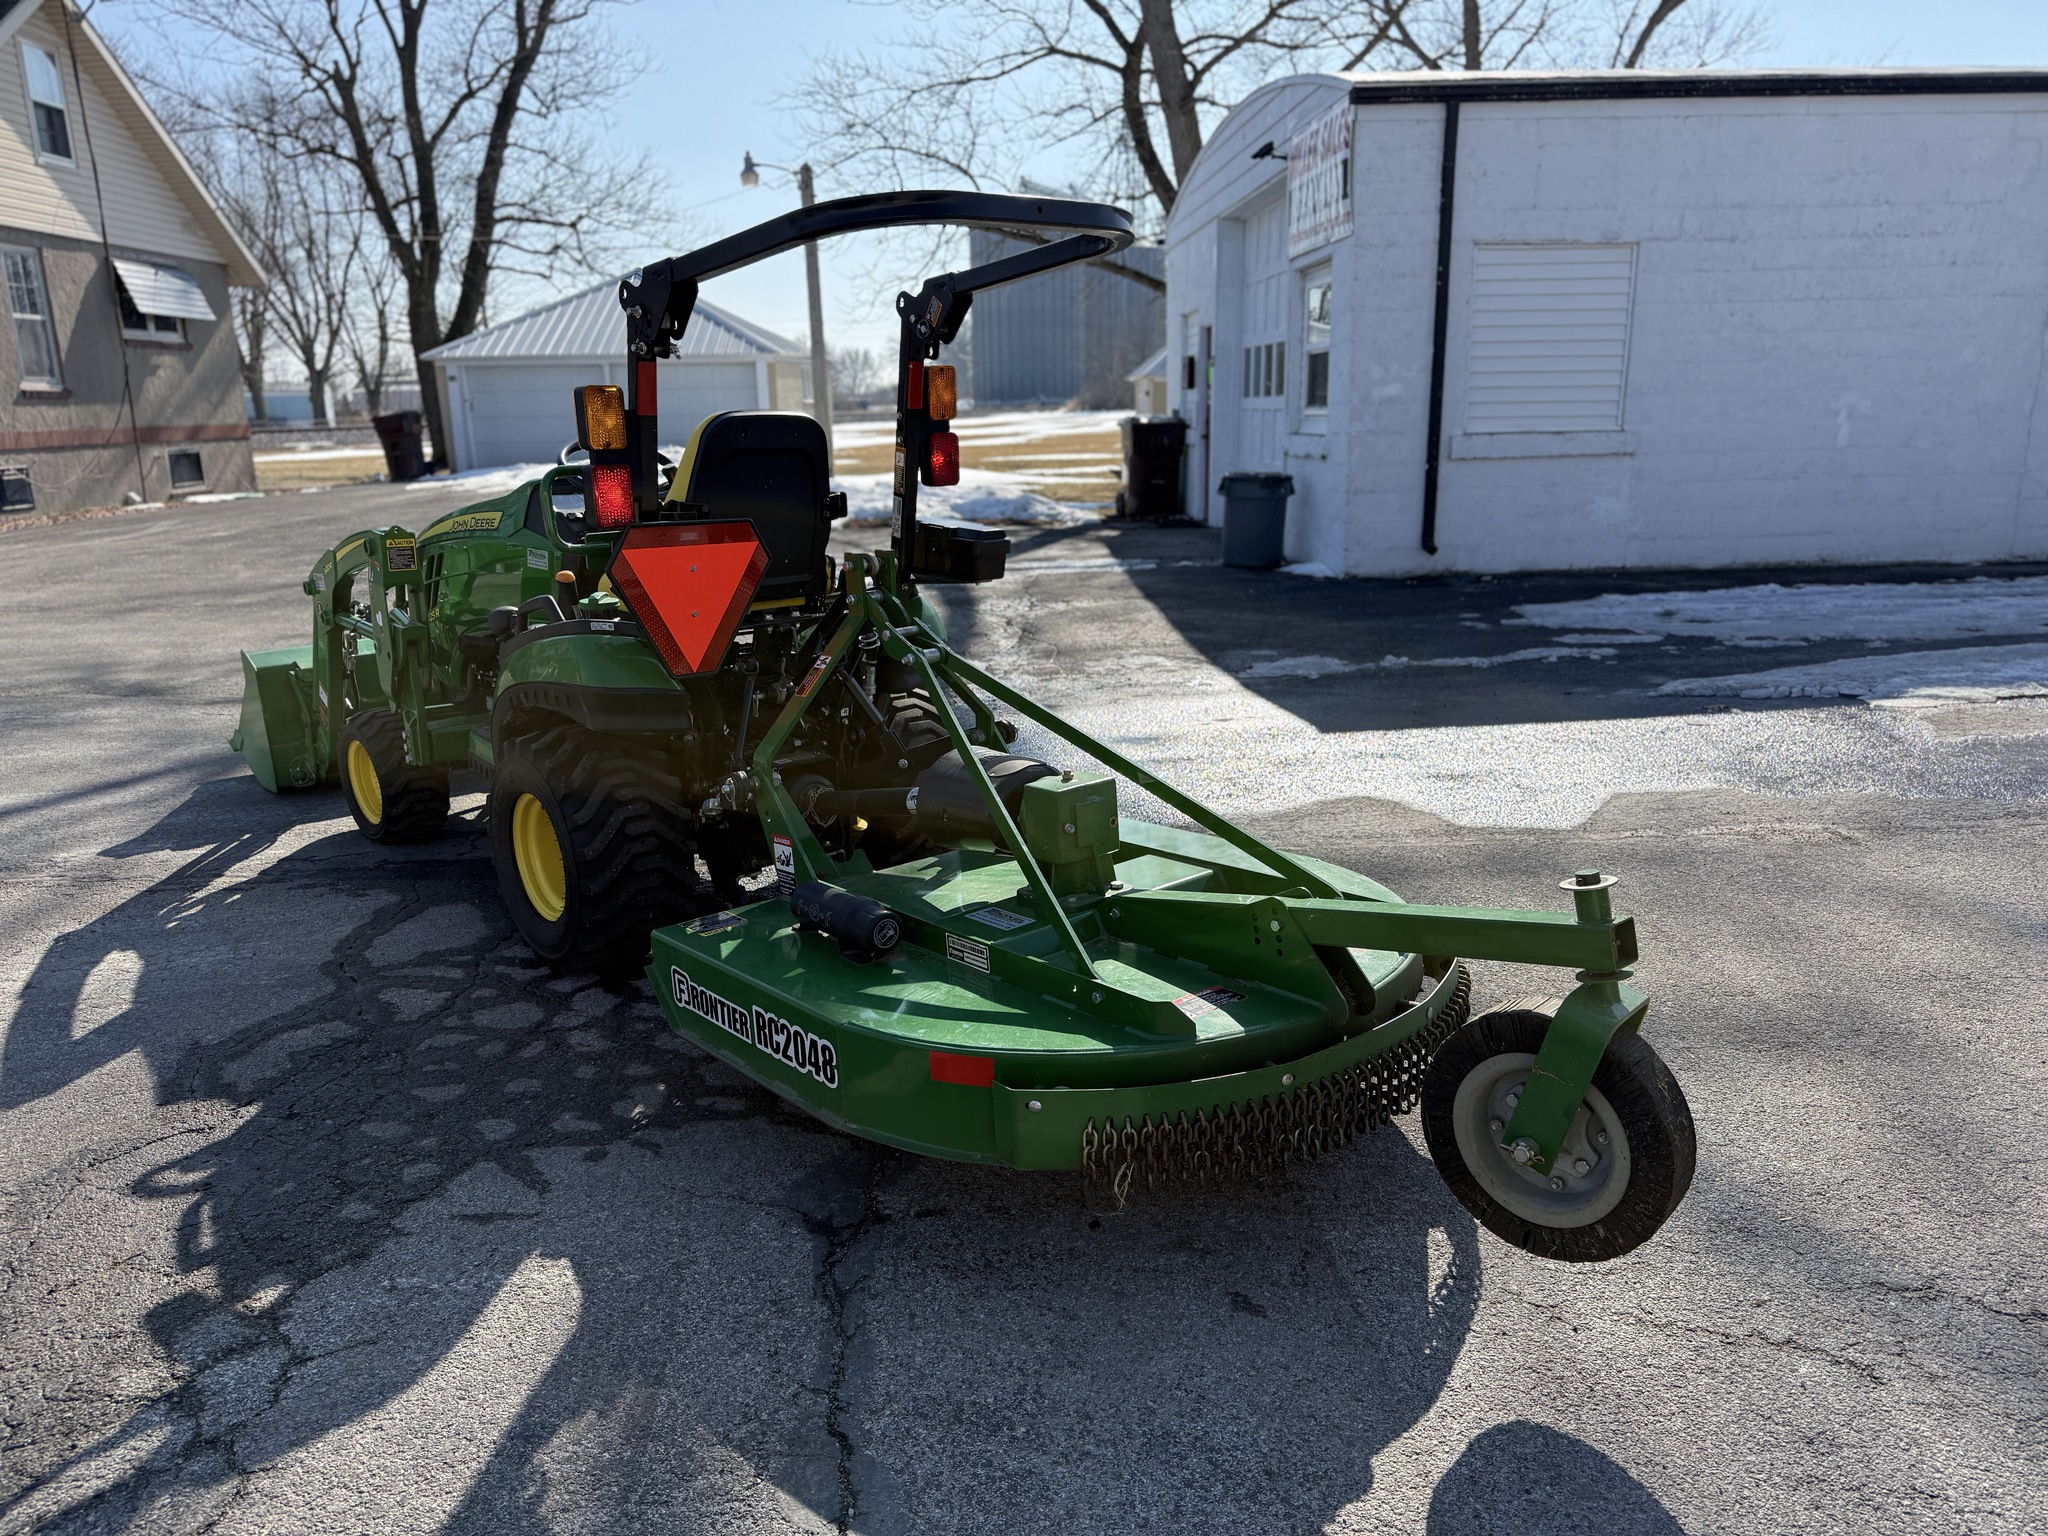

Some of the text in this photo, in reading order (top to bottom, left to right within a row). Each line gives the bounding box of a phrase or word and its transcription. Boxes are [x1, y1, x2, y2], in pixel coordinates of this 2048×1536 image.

[449, 516, 497, 532] JOHN DEERE
[671, 965, 838, 1088] FRONTIER RC2048
